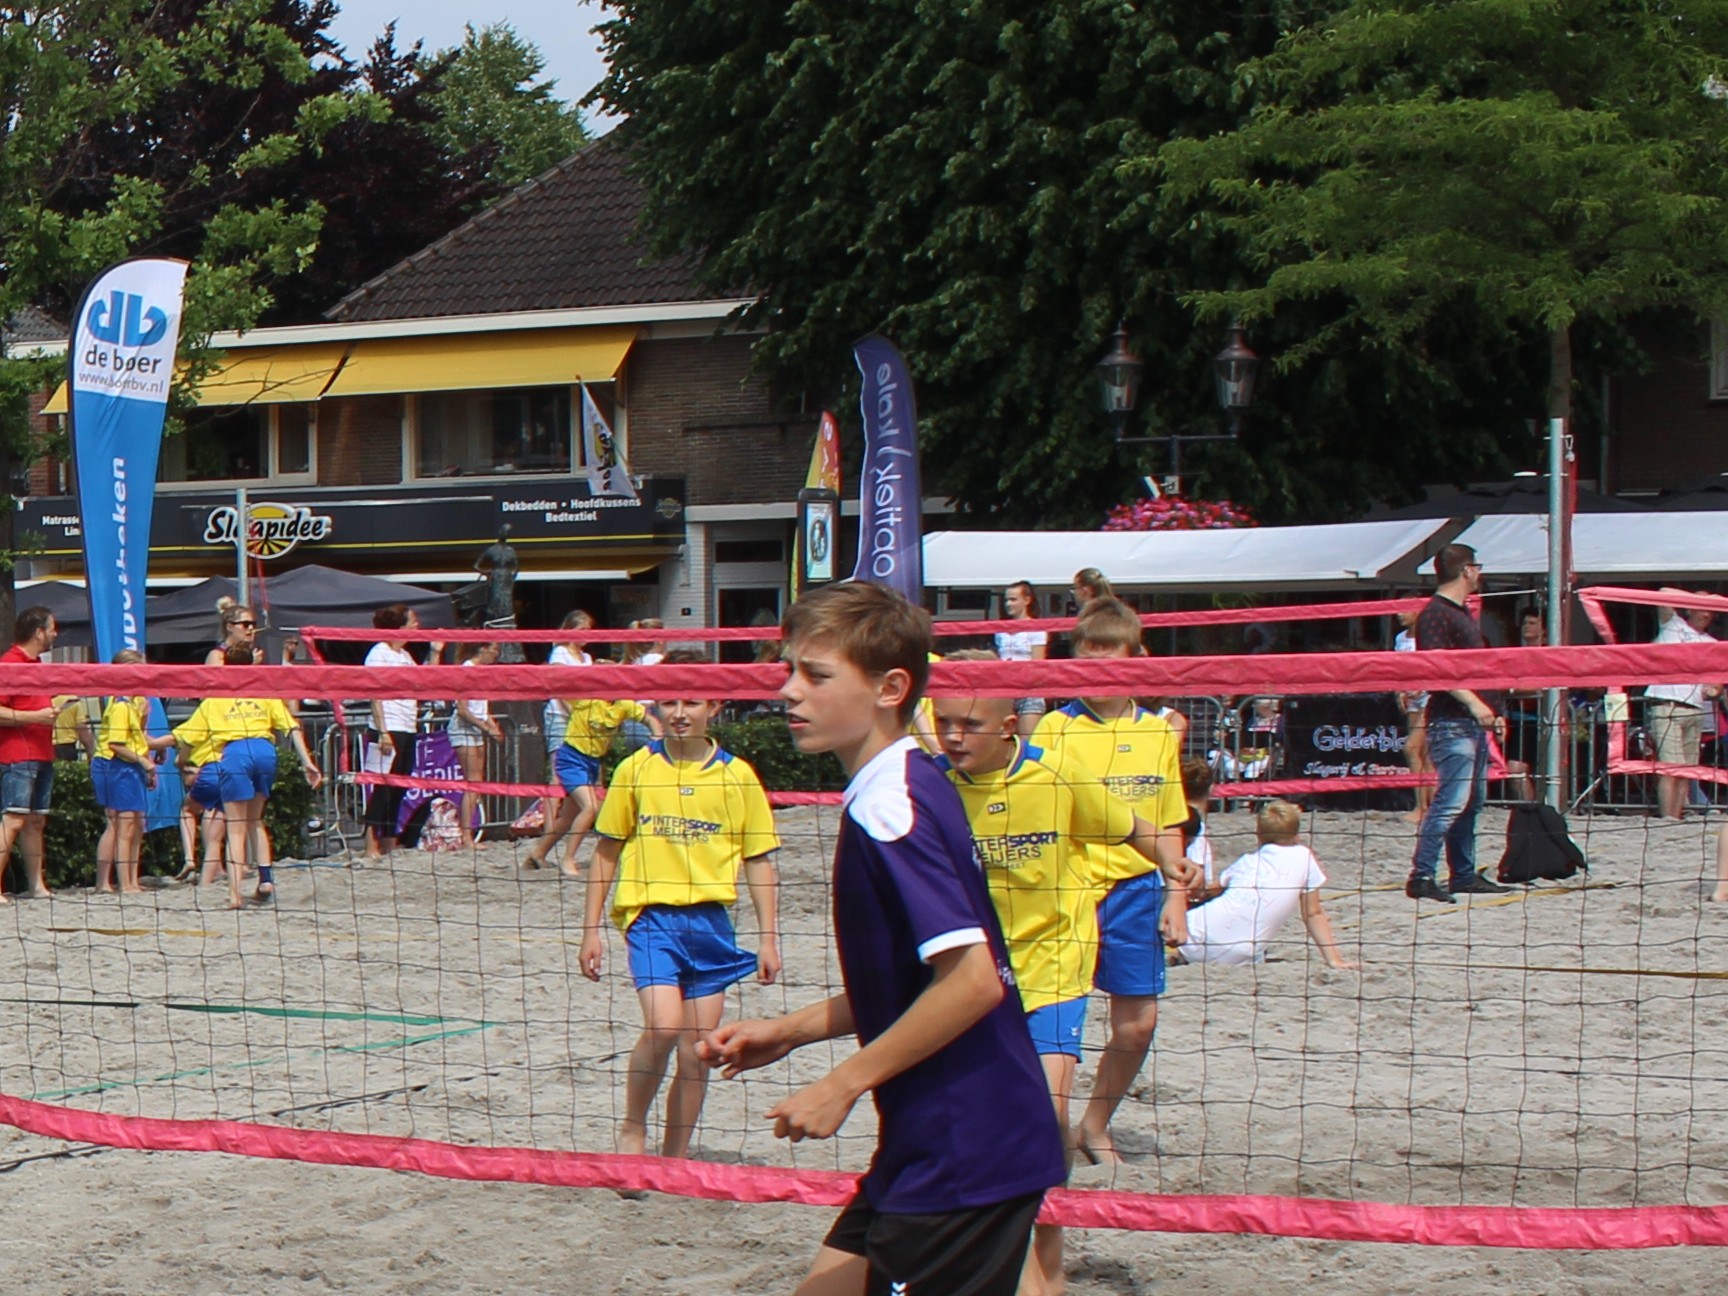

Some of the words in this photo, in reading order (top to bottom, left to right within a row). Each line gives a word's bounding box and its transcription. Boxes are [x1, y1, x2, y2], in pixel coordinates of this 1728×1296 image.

[85, 344, 108, 368] de
[112, 348, 162, 374] boer
[502, 500, 558, 512] Dekbedden
[570, 498, 642, 510] Hoofdkussens
[206, 507, 331, 544] Slapidee
[545, 511, 598, 523] Bedtextiel
[975, 831, 1057, 852] TERSPORT
[981, 846, 1042, 864] EIJERS
